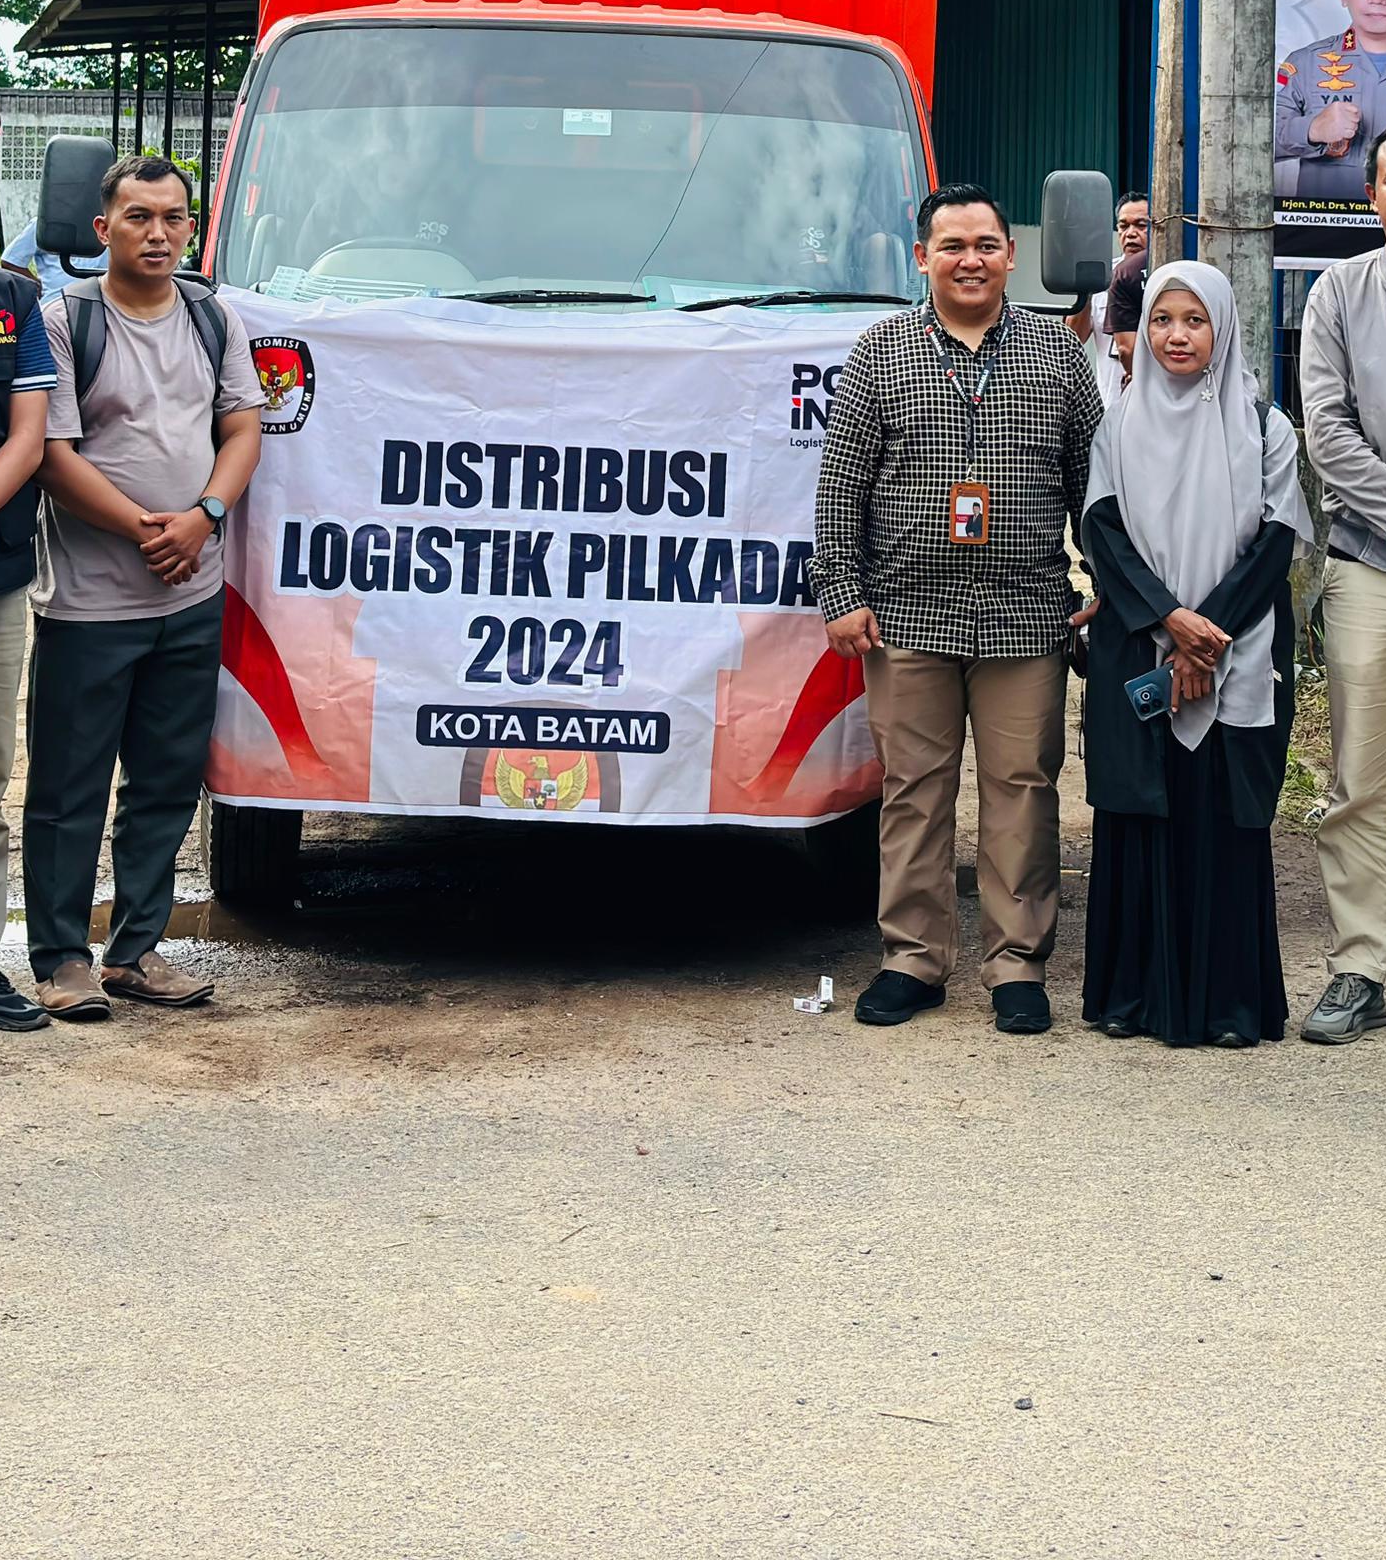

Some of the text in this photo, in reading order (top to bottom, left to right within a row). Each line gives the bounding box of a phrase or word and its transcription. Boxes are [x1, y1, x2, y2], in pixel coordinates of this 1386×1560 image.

[1310, 201, 1327, 209] Pol.
[1328, 202, 1347, 210] Drs.
[1349, 203, 1368, 211] Yan
[1281, 215, 1327, 224] KAPOLDA
[255, 338, 300, 350] KOMISI
[790, 437, 824, 450] Logist
[380, 439, 728, 518] DISTRIBUSI
[280, 521, 819, 607] LOGISTIK PILKADA
[465, 615, 624, 687] 2024
[429, 712, 658, 747] KOTA BATAM
